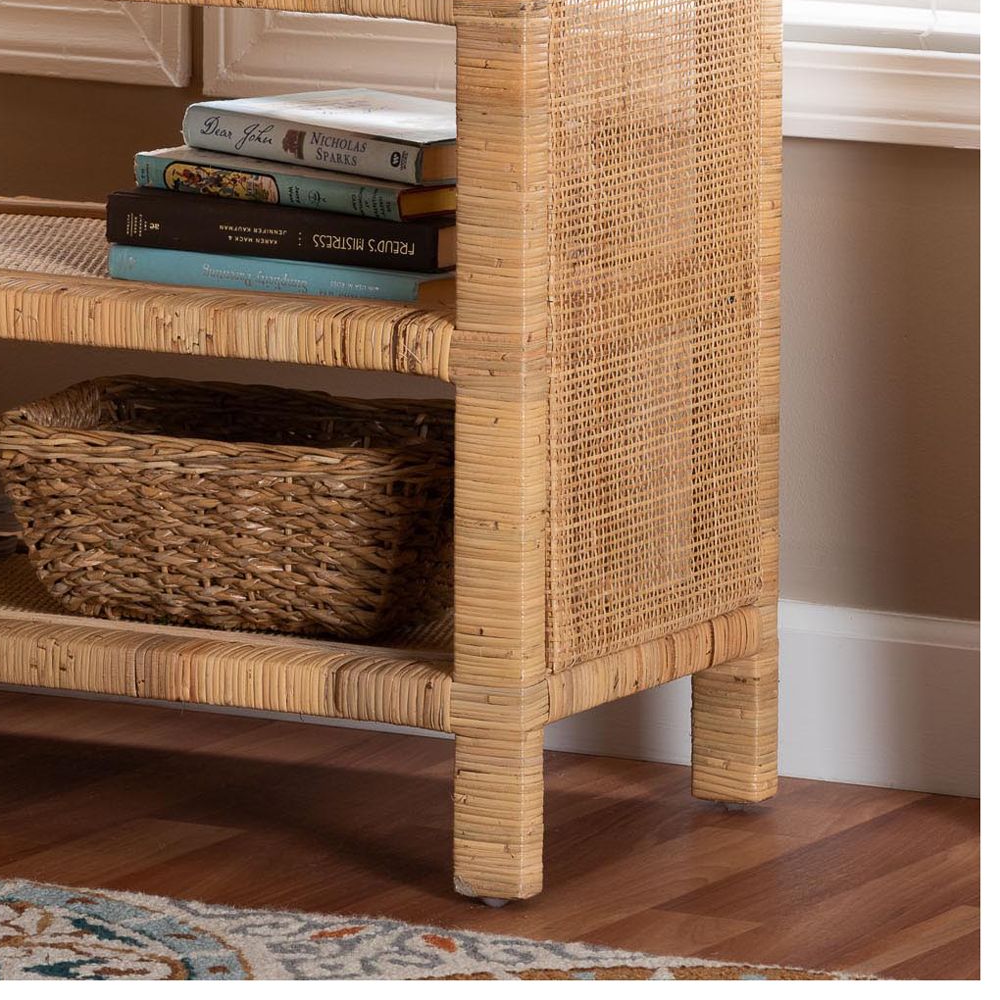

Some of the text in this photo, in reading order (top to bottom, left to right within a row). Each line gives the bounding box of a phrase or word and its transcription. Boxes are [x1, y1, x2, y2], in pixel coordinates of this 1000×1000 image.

[200, 116, 275, 150] Dear John
[310, 131, 368, 154] NICHOLAS
[316, 147, 358, 167] SPARKS
[218, 223, 288, 235] JENNIFER KAUFMAN
[233, 235, 253, 244] MACK
[255, 237, 278, 246] KAREN
[312, 234, 416, 256] FREUD'S MISTRESS
[201, 263, 309, 293] Simplicity Parenting
